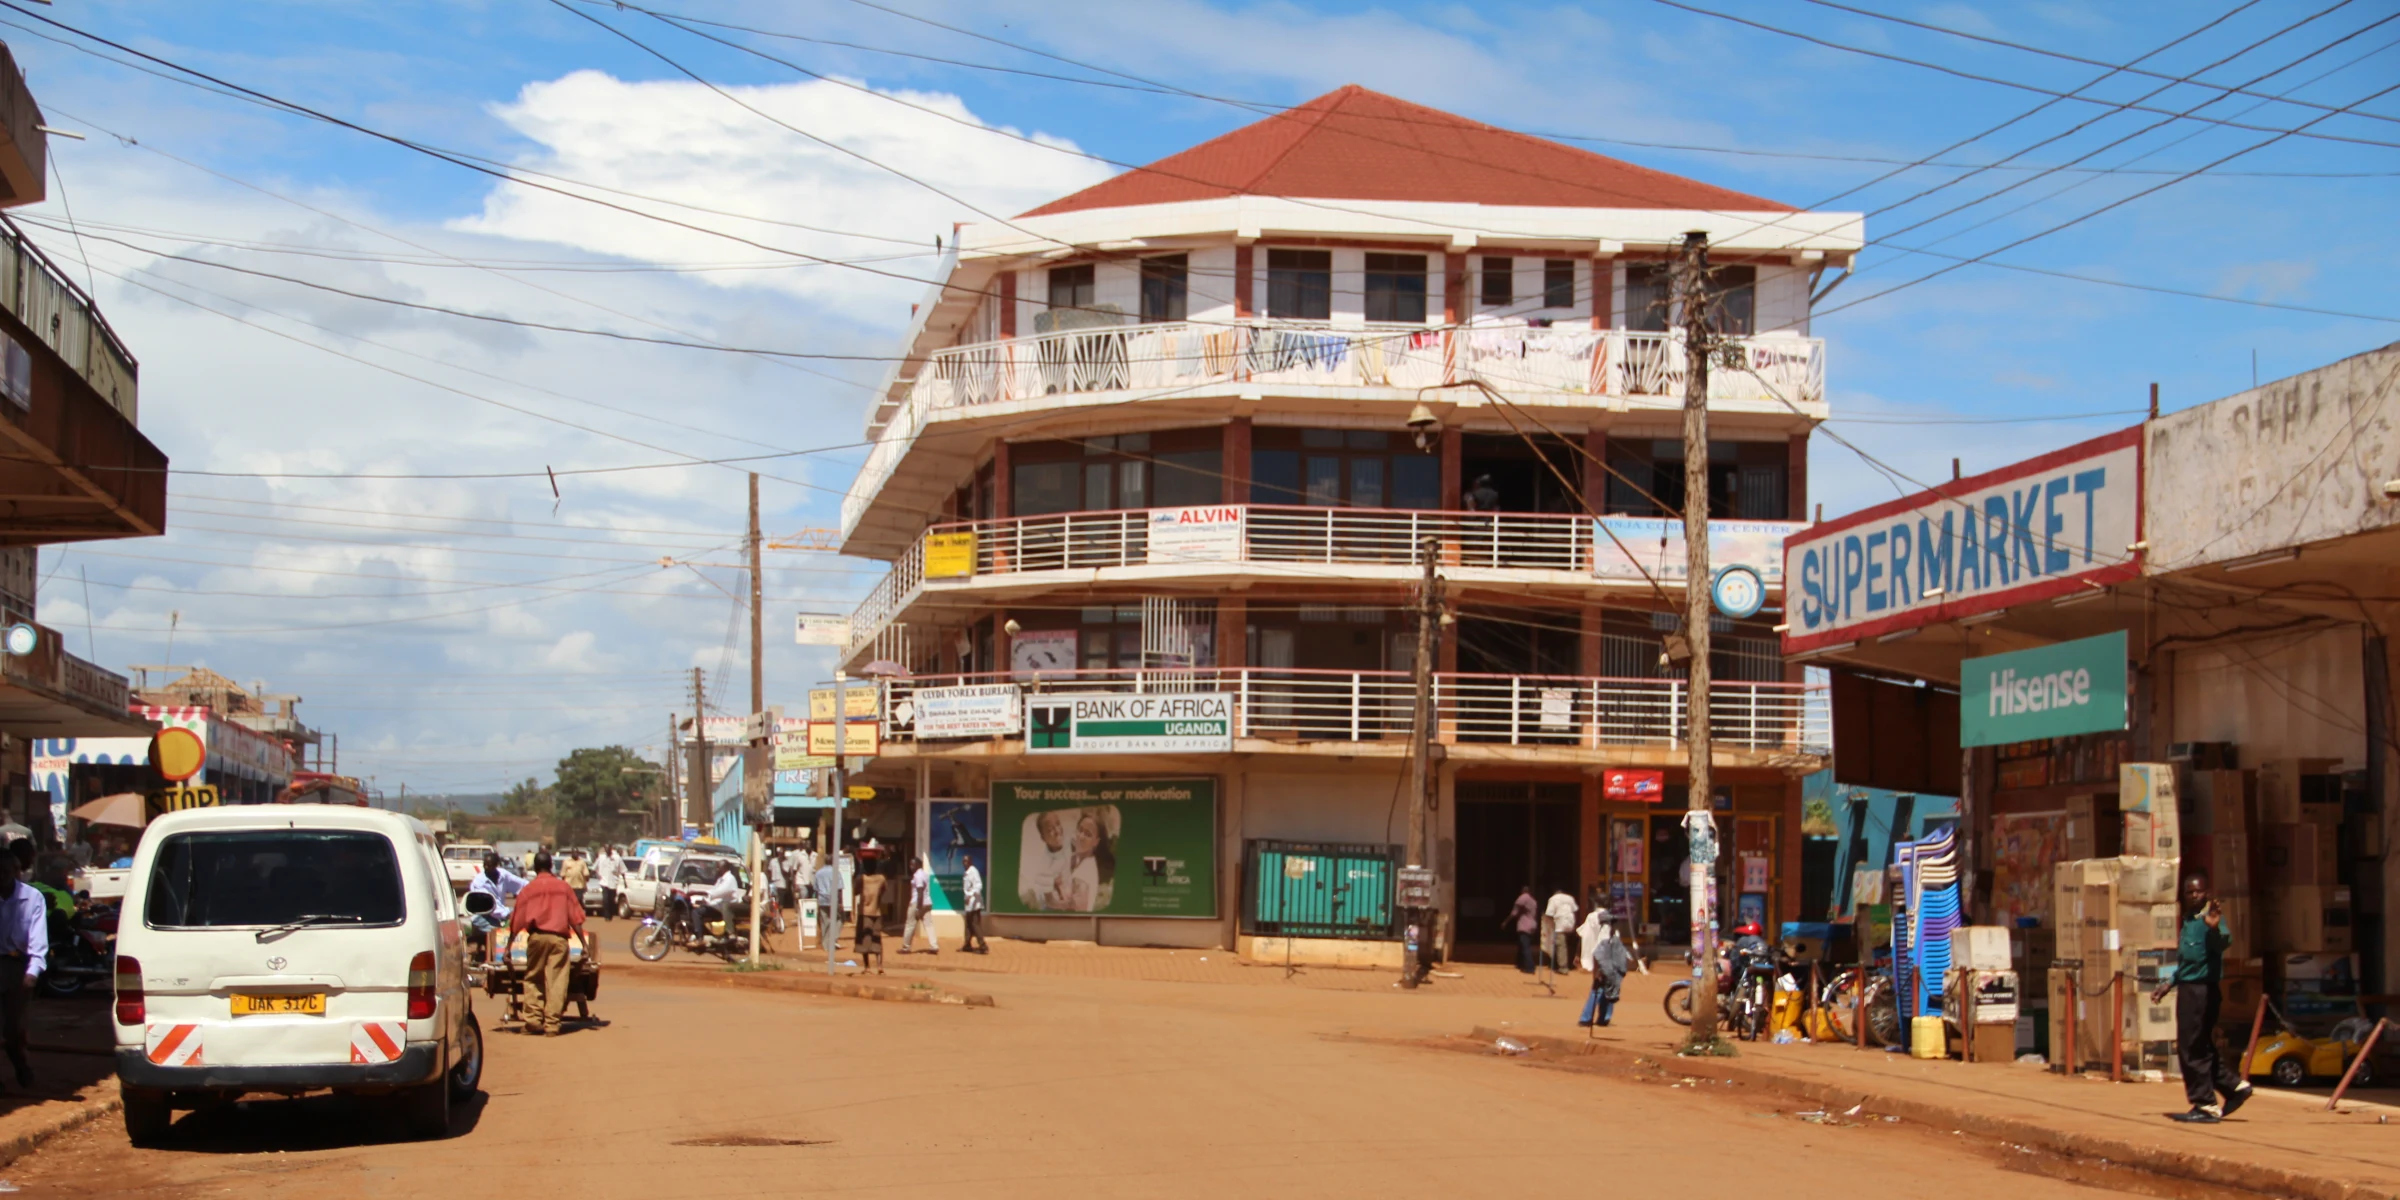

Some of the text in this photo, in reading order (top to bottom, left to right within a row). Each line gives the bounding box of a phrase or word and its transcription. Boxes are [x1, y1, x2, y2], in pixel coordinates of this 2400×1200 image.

[1180, 508, 1238, 524] ALVIN
[1732, 524, 1791, 534] CENTER
[1801, 467, 2106, 629] SUPERMARKET
[922, 686, 1015, 699] CLYDE FOREX BUREAU
[1989, 667, 2090, 717] Hisense
[1076, 698, 1226, 719] BANK OF AFRICA
[1165, 722, 1222, 736] UGANDA
[815, 737, 870, 745] MonGram
[1076, 739, 1228, 749] GROUPE BANK OF AFRICA
[1013, 785, 1041, 799] Your
[1101, 788, 1123, 799] our
[1126, 785, 1192, 799] motivation
[148, 789, 215, 813] STOP
[248, 995, 318, 1011] UAK 317C
[355, 1053, 361, 1062] R
